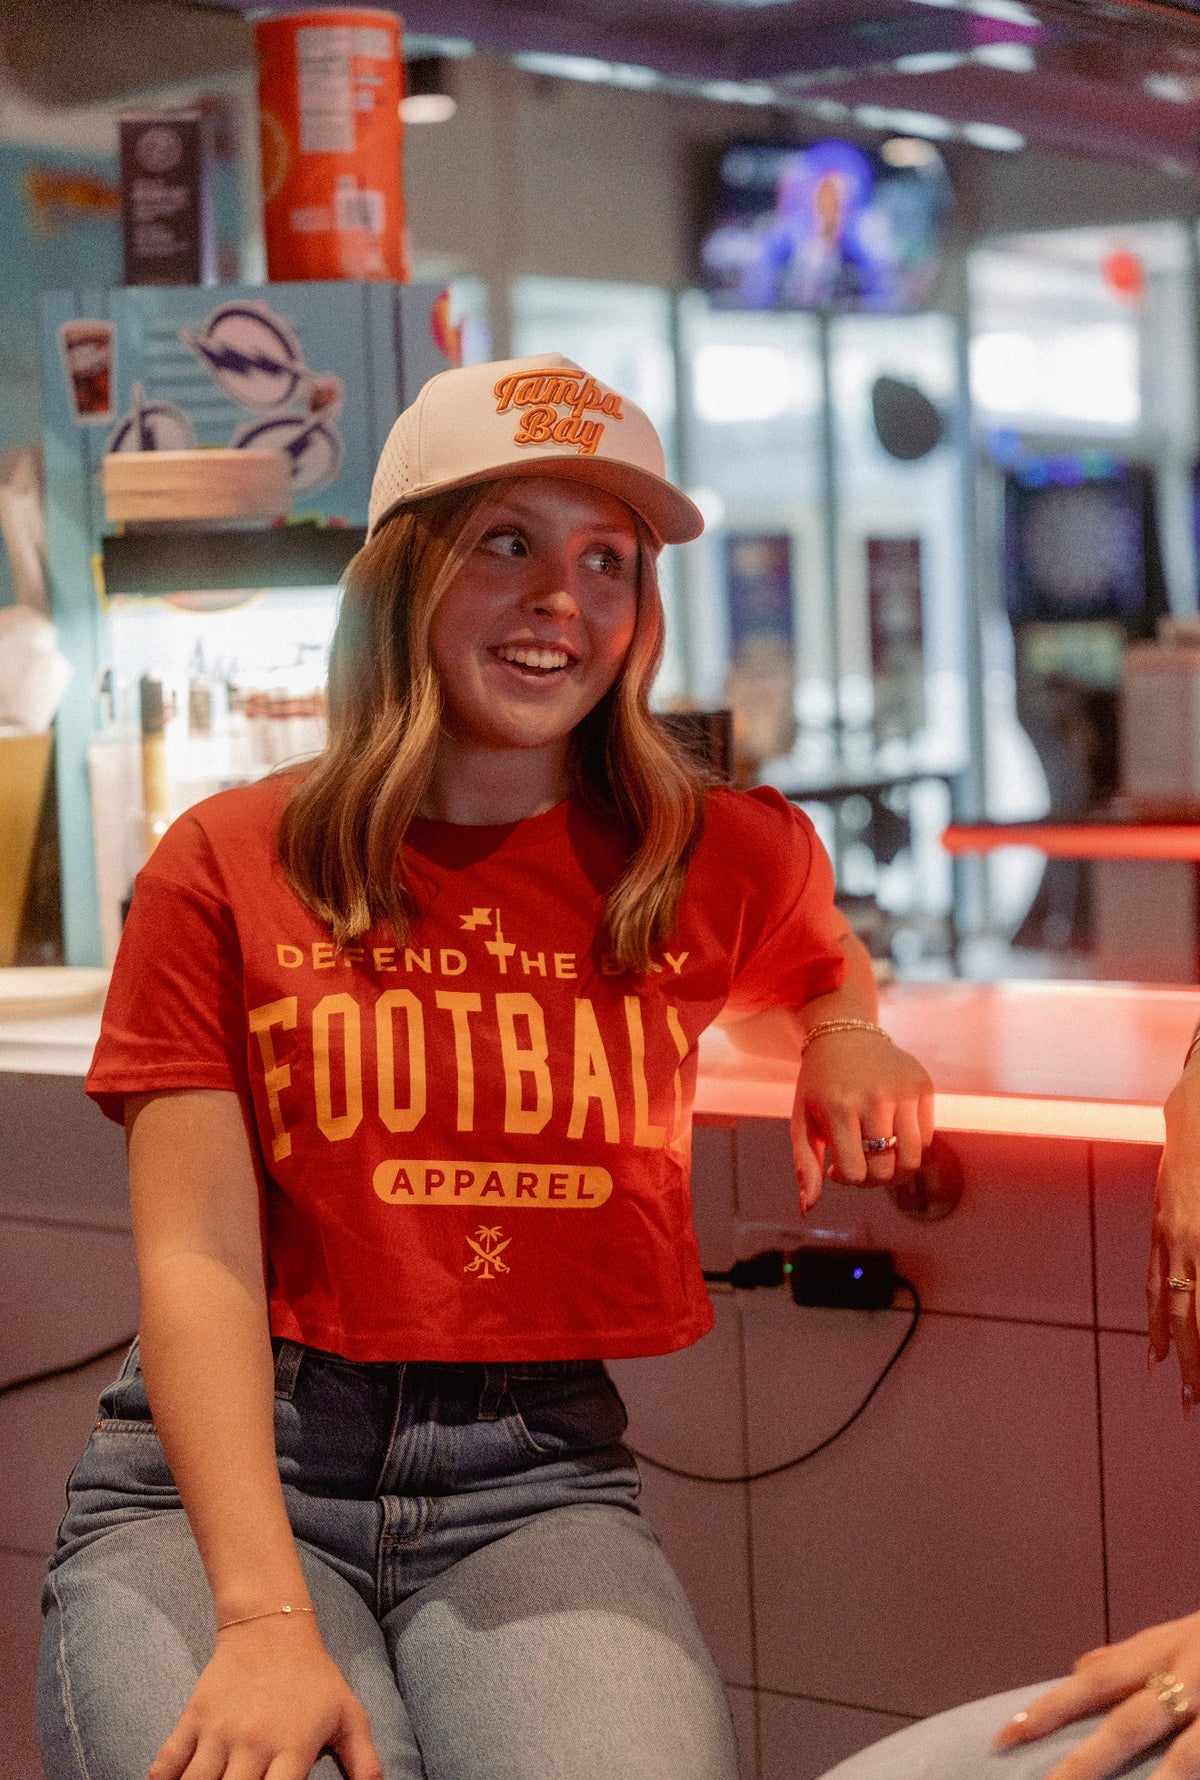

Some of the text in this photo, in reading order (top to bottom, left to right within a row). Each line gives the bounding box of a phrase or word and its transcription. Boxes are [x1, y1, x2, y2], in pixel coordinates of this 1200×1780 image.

[494, 368, 624, 420] Tampa
[514, 405, 605, 455] Bay
[276, 942, 467, 976] DEFEND
[484, 937, 578, 979] THE
[390, 1167, 596, 1200] APPAREL
